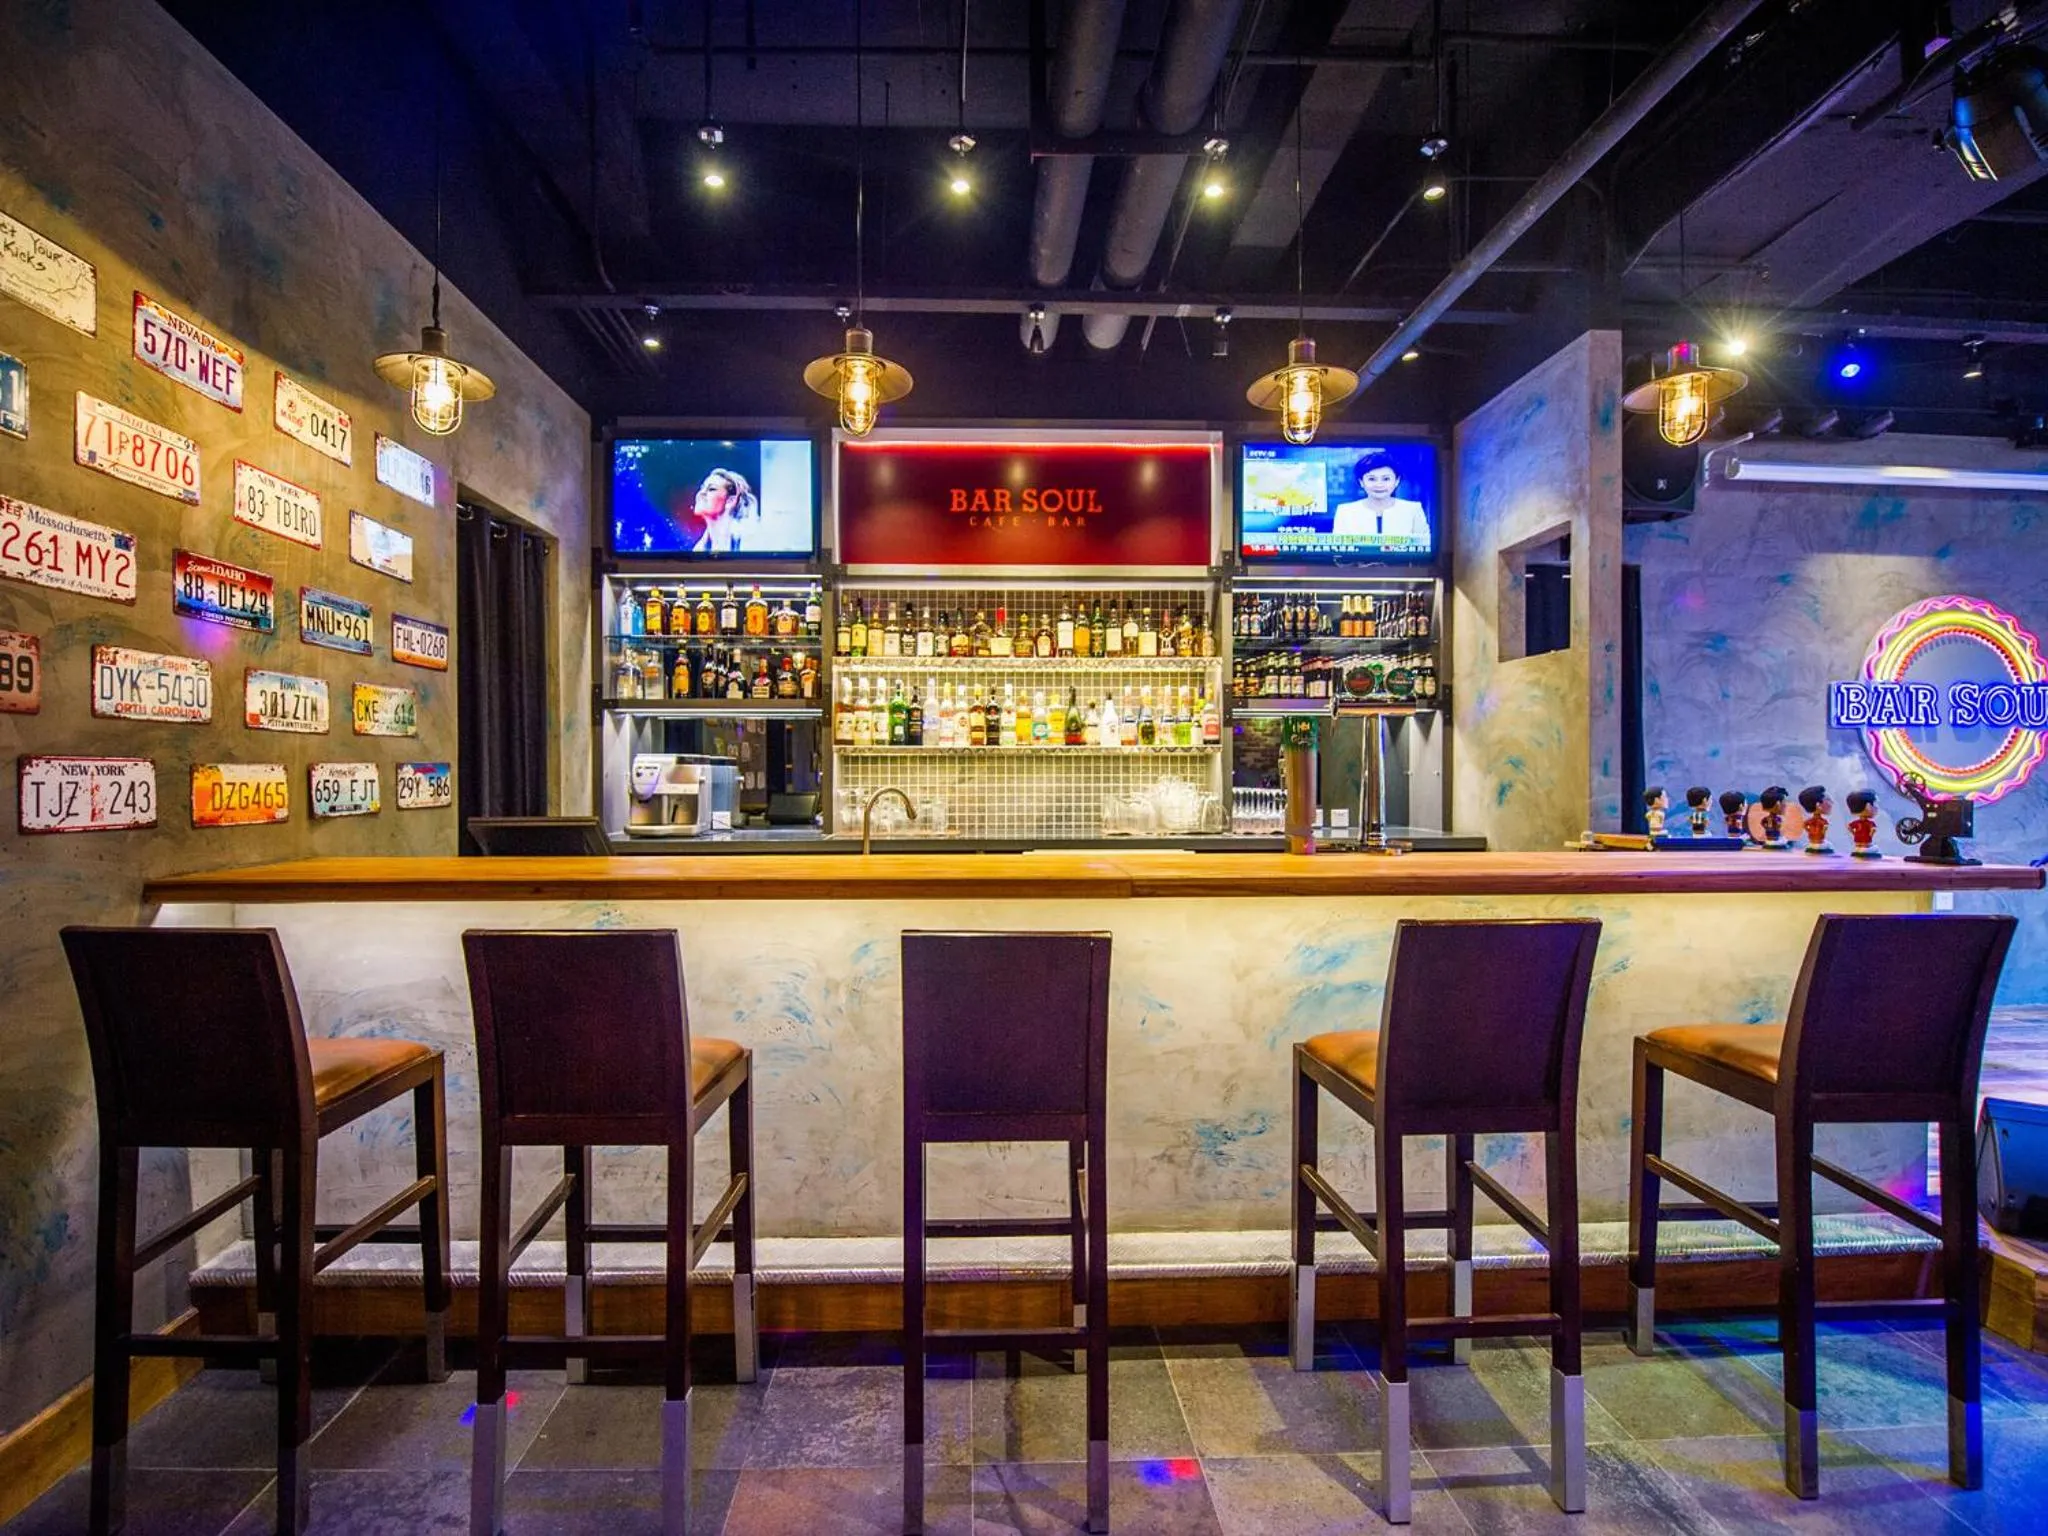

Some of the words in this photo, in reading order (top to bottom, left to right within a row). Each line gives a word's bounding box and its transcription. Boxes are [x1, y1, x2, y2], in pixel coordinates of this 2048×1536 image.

[4, 238, 46, 271] Kicks
[166, 314, 217, 350] NEVADA
[311, 413, 347, 452] 0417
[248, 485, 265, 519] 83
[275, 495, 316, 537] TBIRD
[950, 488, 1012, 512] BAR
[1022, 488, 1103, 513] SOUL
[27, 508, 107, 543] Massachusetts
[969, 516, 1021, 527] CAFE
[1048, 516, 1086, 527] BAR
[2, 521, 64, 573] 261
[76, 540, 130, 589] MY2
[211, 564, 246, 583] IDAHO
[183, 572, 204, 602] 8B
[218, 580, 268, 616] DE129
[100, 665, 207, 708] DYK-5430
[1837, 682, 1940, 725] BAR
[151, 705, 203, 718] CAROLINA
[60, 764, 91, 776] NEW
[95, 764, 126, 776] YORK
[30, 781, 80, 818] TJZ
[109, 780, 151, 815] 243
[212, 781, 285, 811] DZG465
[315, 779, 340, 803] 659
[350, 779, 376, 802] FJT
[399, 777, 421, 799] 29Y
[428, 776, 450, 797] 586
